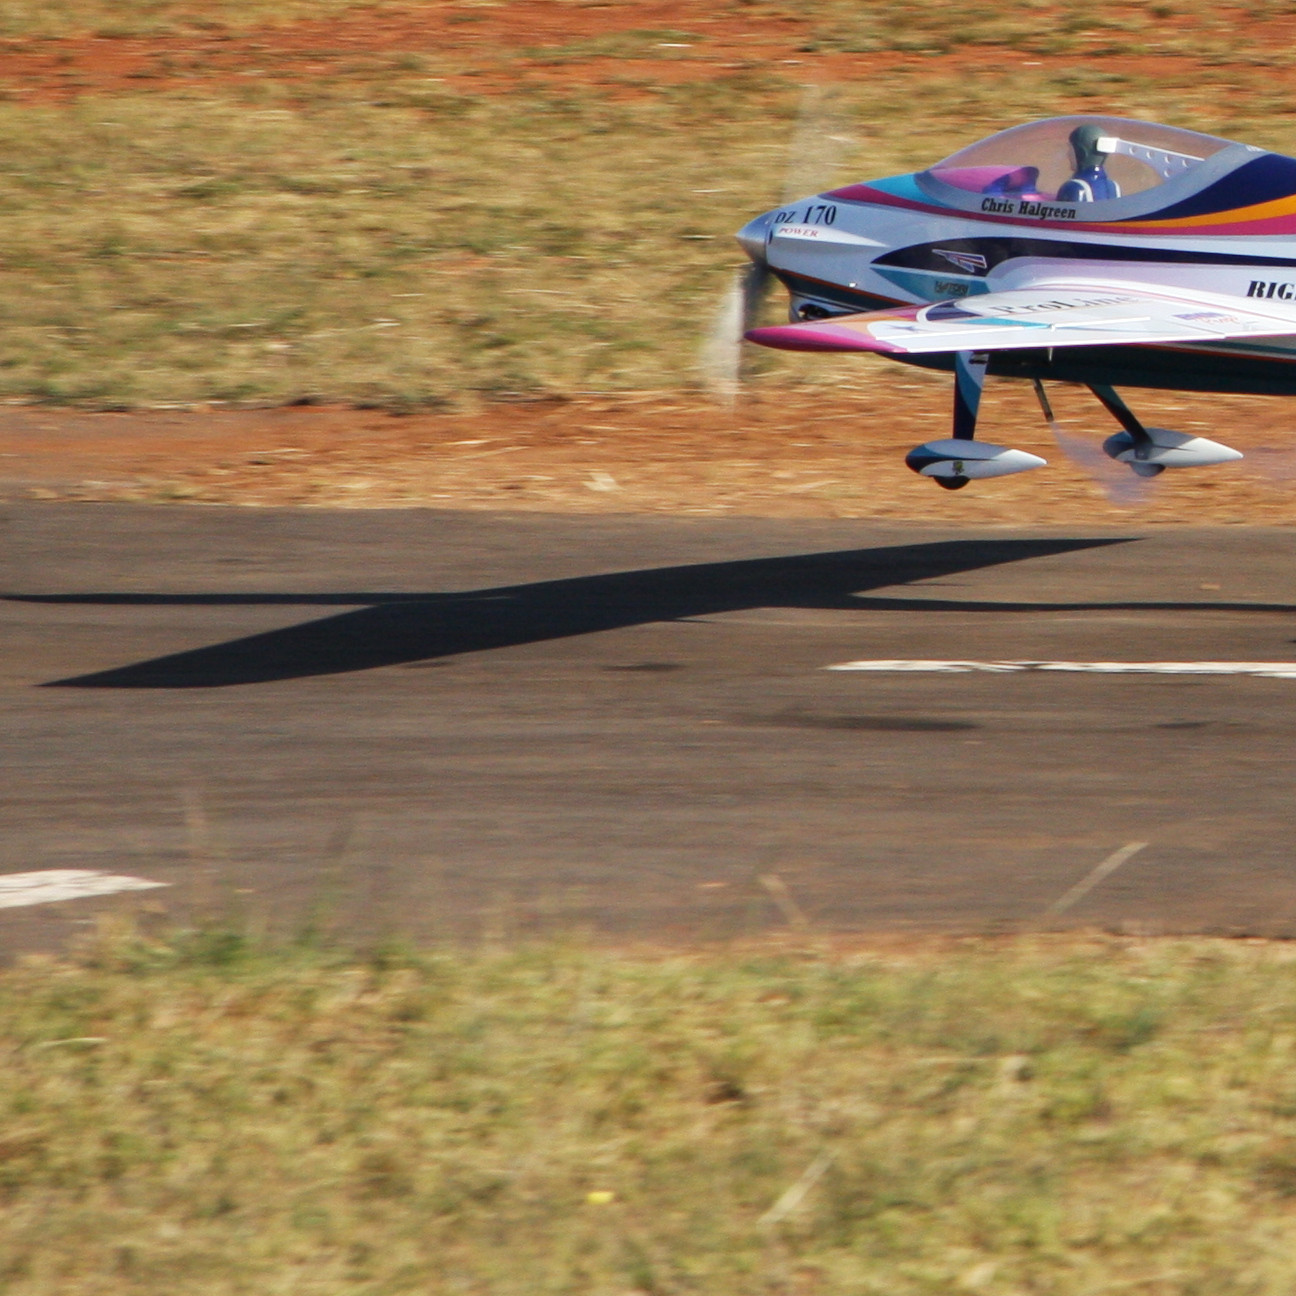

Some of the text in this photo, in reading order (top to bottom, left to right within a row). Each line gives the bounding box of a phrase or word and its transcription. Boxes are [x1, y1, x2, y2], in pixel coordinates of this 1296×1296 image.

[802, 205, 837, 225] 170
[981, 197, 1076, 220] Chris Halgreen
[779, 227, 819, 237] POWER
